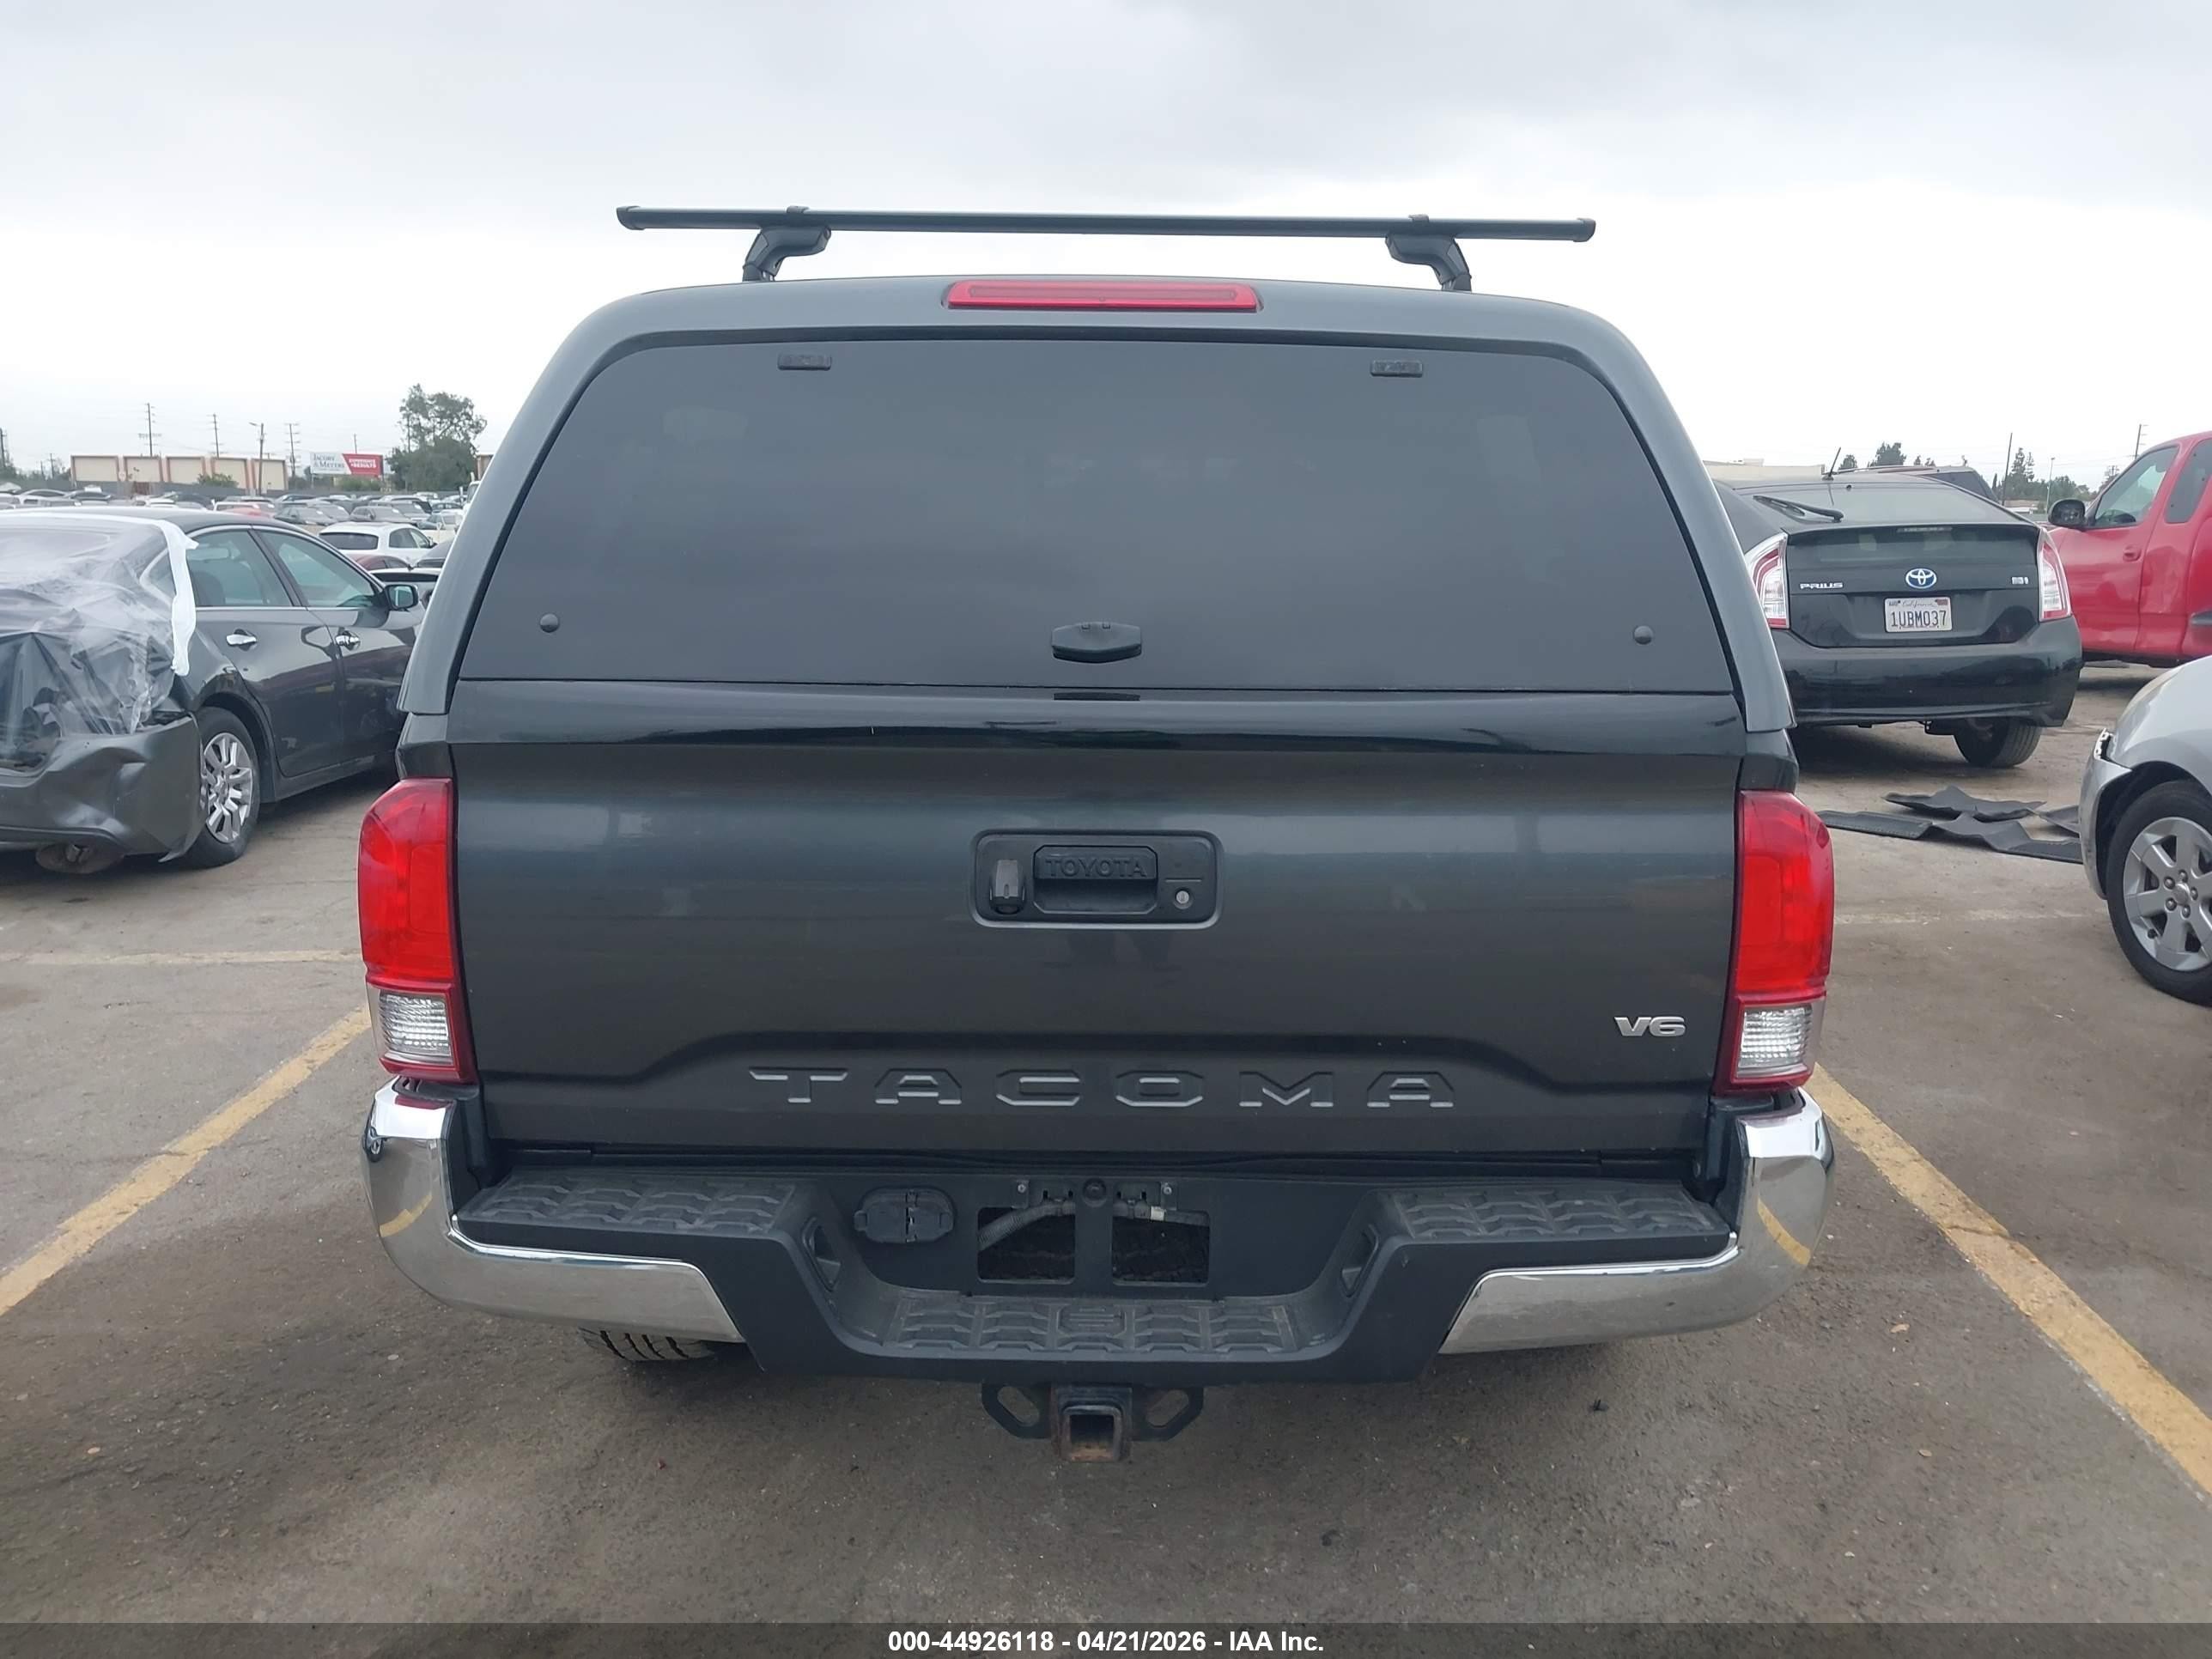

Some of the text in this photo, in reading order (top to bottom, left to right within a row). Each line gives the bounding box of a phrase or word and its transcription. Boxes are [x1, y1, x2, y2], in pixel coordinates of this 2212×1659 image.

[1891, 610, 1947, 627] 1UBM037
[1044, 859, 1147, 878] TOYOTA
[1614, 1016, 1686, 1037] V6
[749, 1066, 1454, 1108] TACOMA
